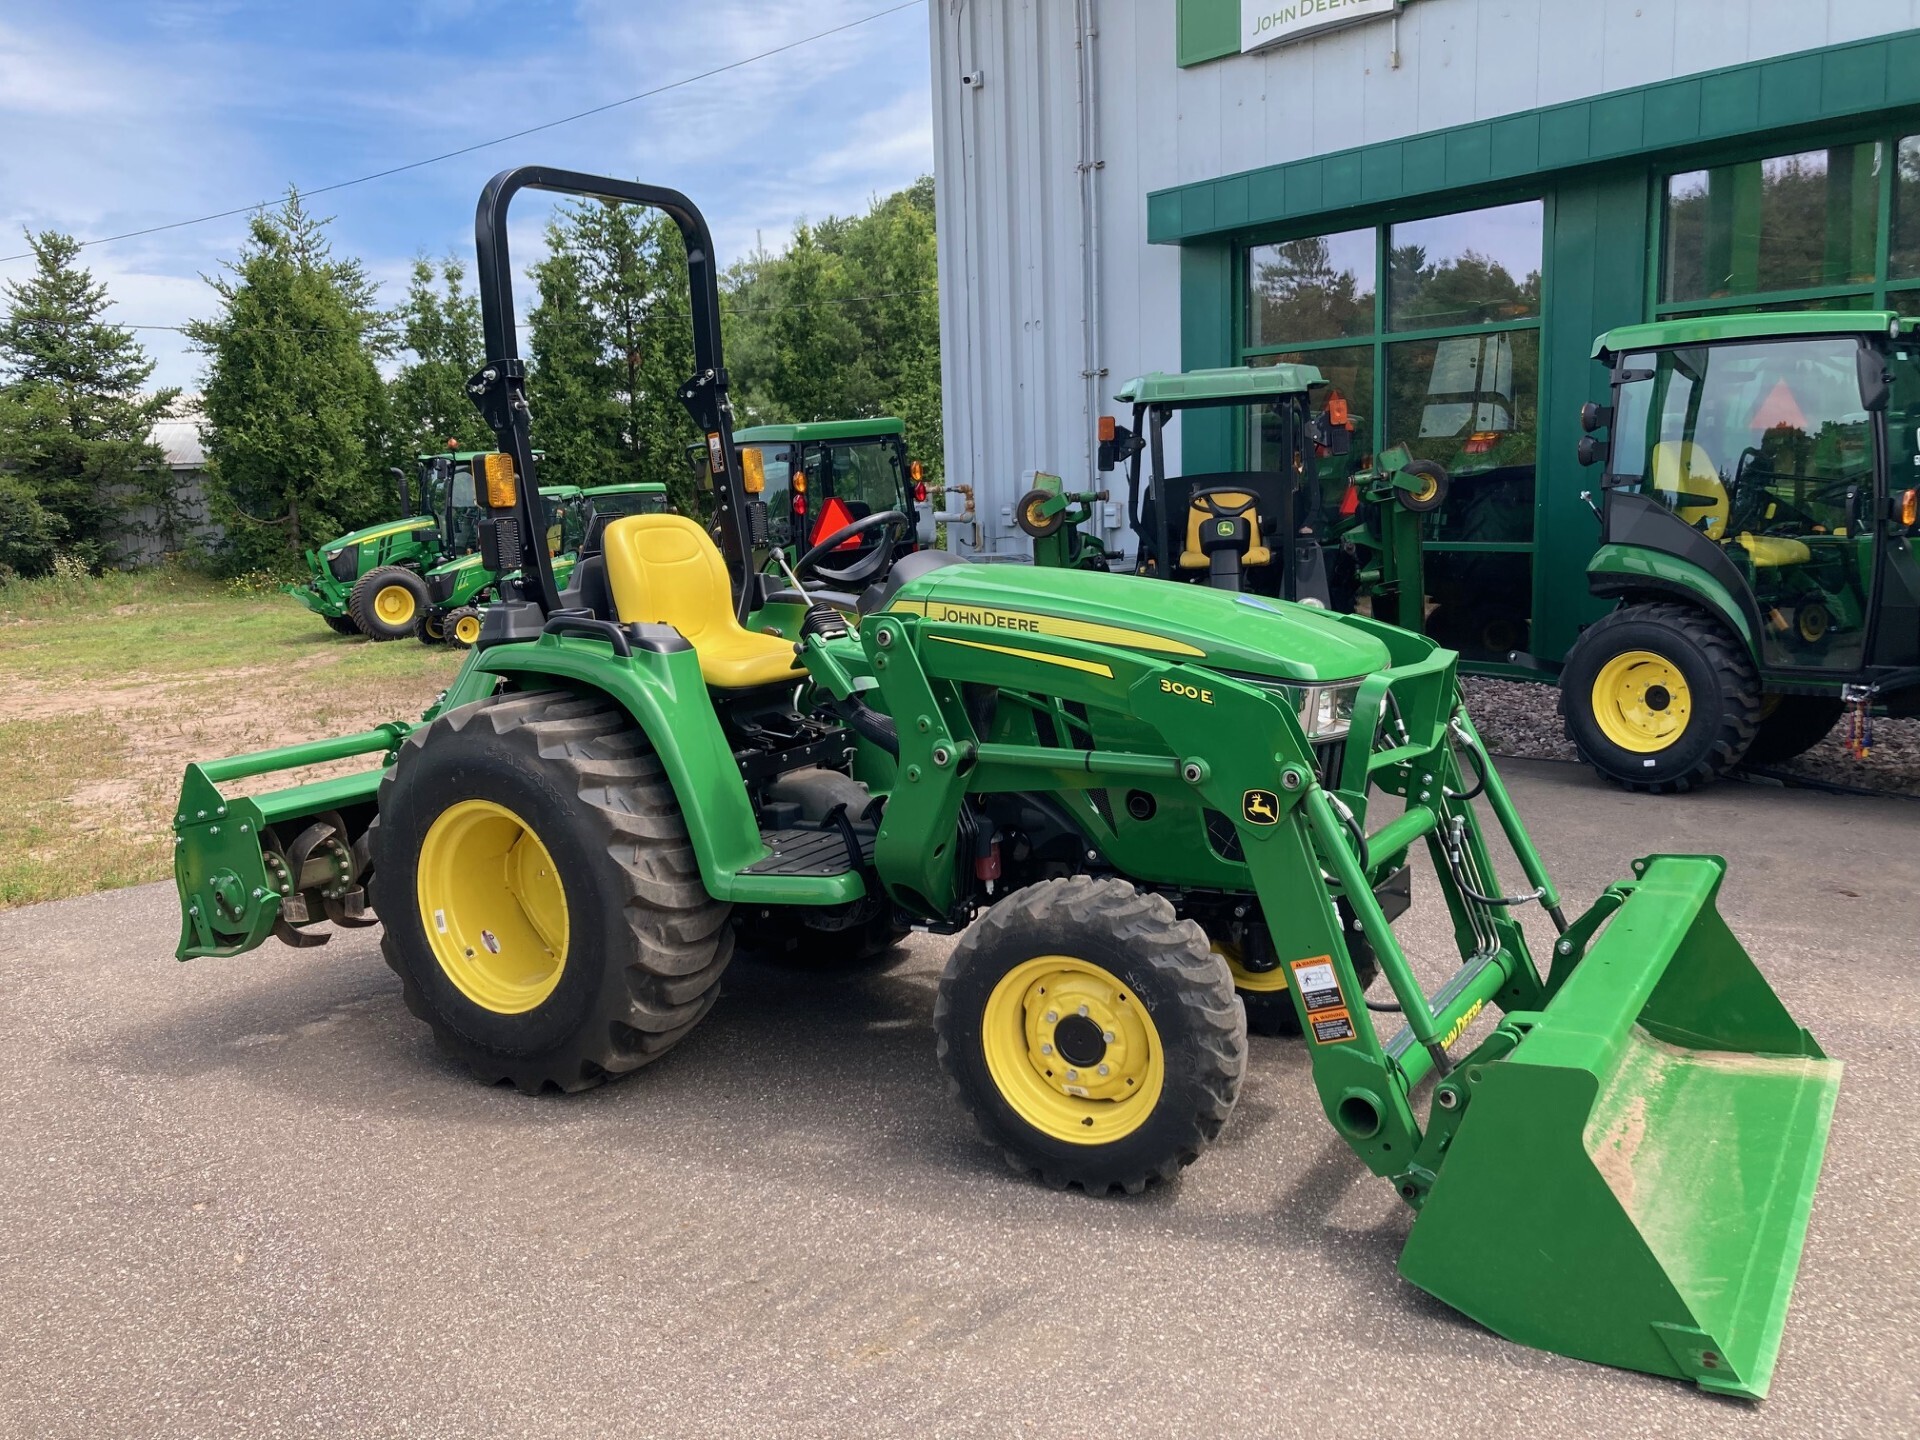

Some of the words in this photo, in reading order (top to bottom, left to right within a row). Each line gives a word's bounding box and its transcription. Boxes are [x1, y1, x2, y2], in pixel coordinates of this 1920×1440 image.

[1253, 6, 1296, 35] JOHN
[1300, 0, 1372, 17] DEE
[939, 606, 981, 626] JOHN
[984, 612, 1040, 633] DEERE
[1160, 679, 1198, 699] 300
[1201, 689, 1213, 704] E
[485, 746, 576, 816] GALAXY
[1440, 1026, 1457, 1051] OHN
